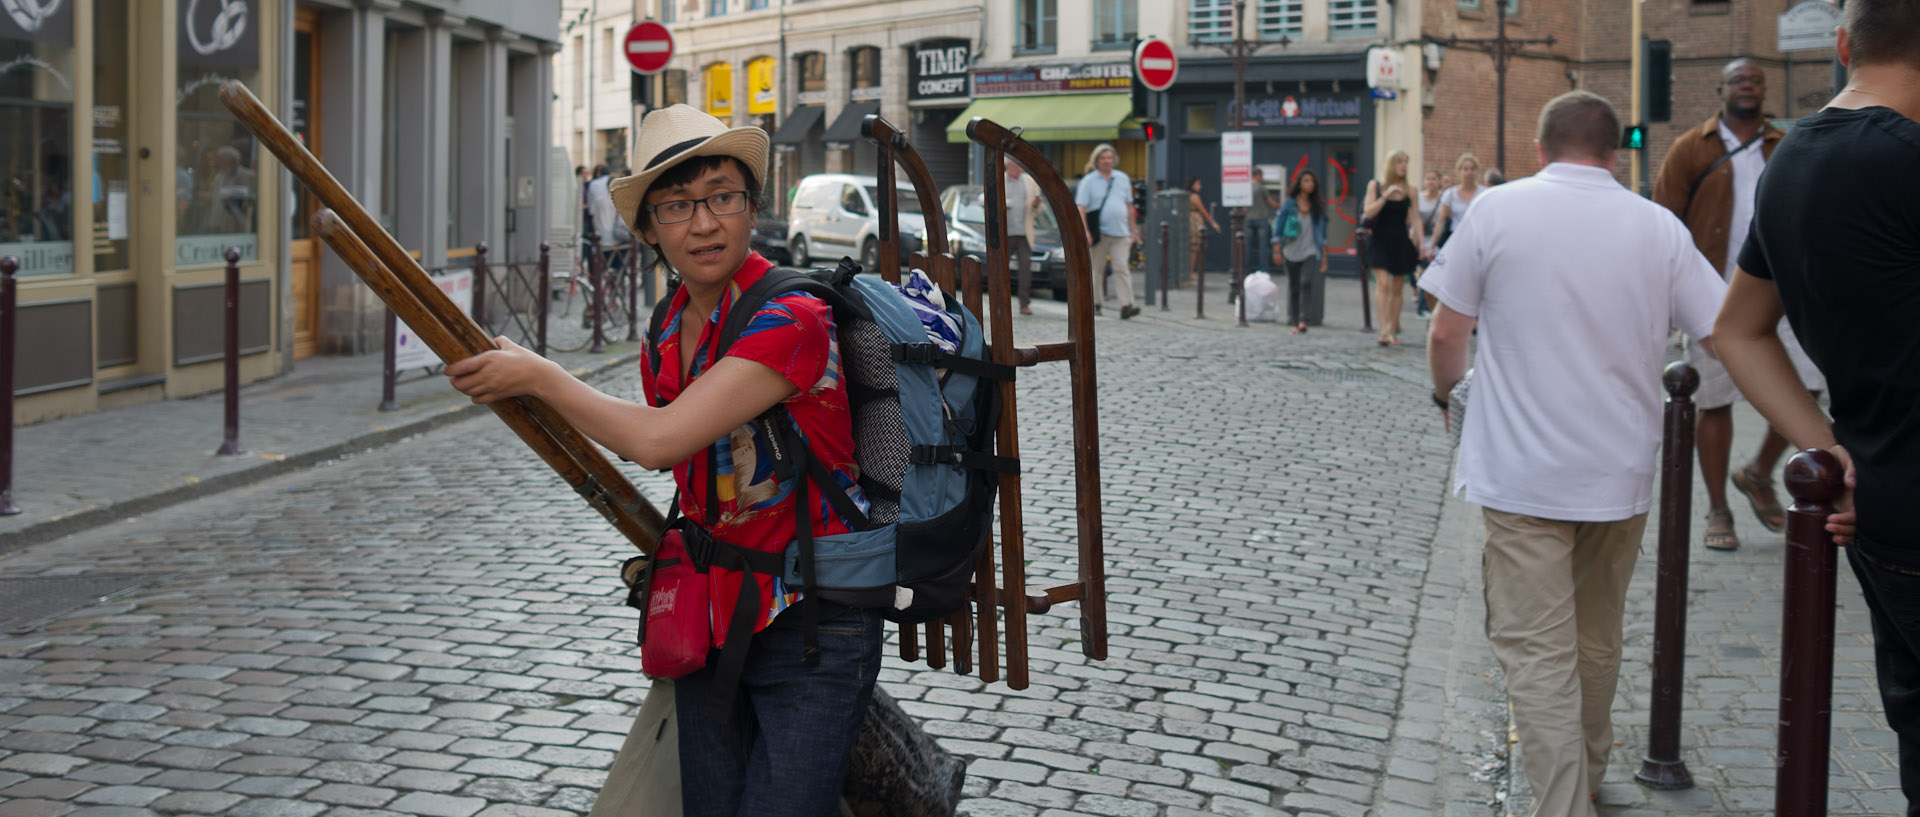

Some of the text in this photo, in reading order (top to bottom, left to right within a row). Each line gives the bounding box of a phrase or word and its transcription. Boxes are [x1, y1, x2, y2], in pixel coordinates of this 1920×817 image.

[916, 47, 969, 76] TIME
[918, 77, 966, 95] CONCEPT
[1301, 96, 1361, 116] Mutuel
[764, 418, 782, 461] Quechua
